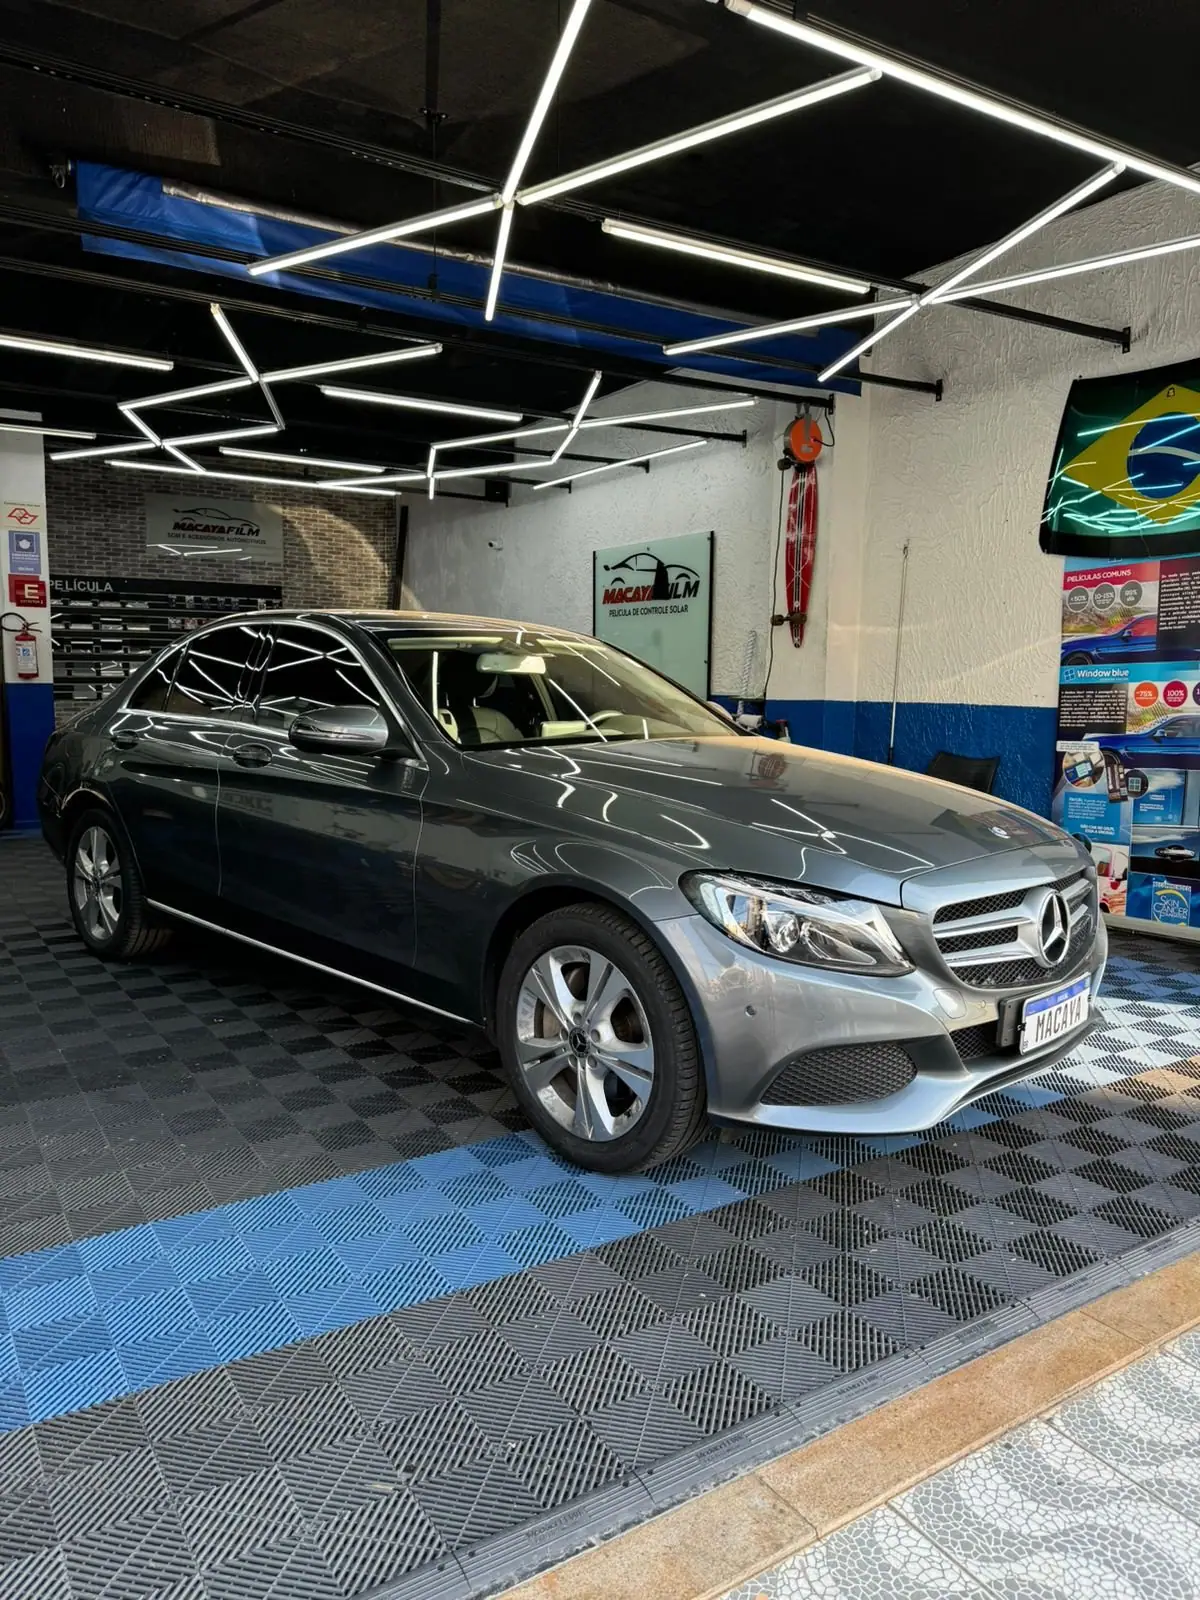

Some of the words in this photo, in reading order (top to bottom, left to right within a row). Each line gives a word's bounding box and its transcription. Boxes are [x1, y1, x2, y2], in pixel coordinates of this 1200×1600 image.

[1067, 573, 1101, 582] PELÍCULAS
[1102, 569, 1132, 579] COMUNS
[24, 584, 39, 599] E
[633, 608, 639, 616] DE
[640, 606, 668, 616] CONTROLE
[669, 604, 689, 614] SOLAR
[1077, 669, 1111, 677] Window
[1111, 668, 1129, 677] blue
[1161, 896, 1179, 908] SKIN
[1153, 902, 1188, 916] CANCER
[1035, 995, 1082, 1043] MACAYA
